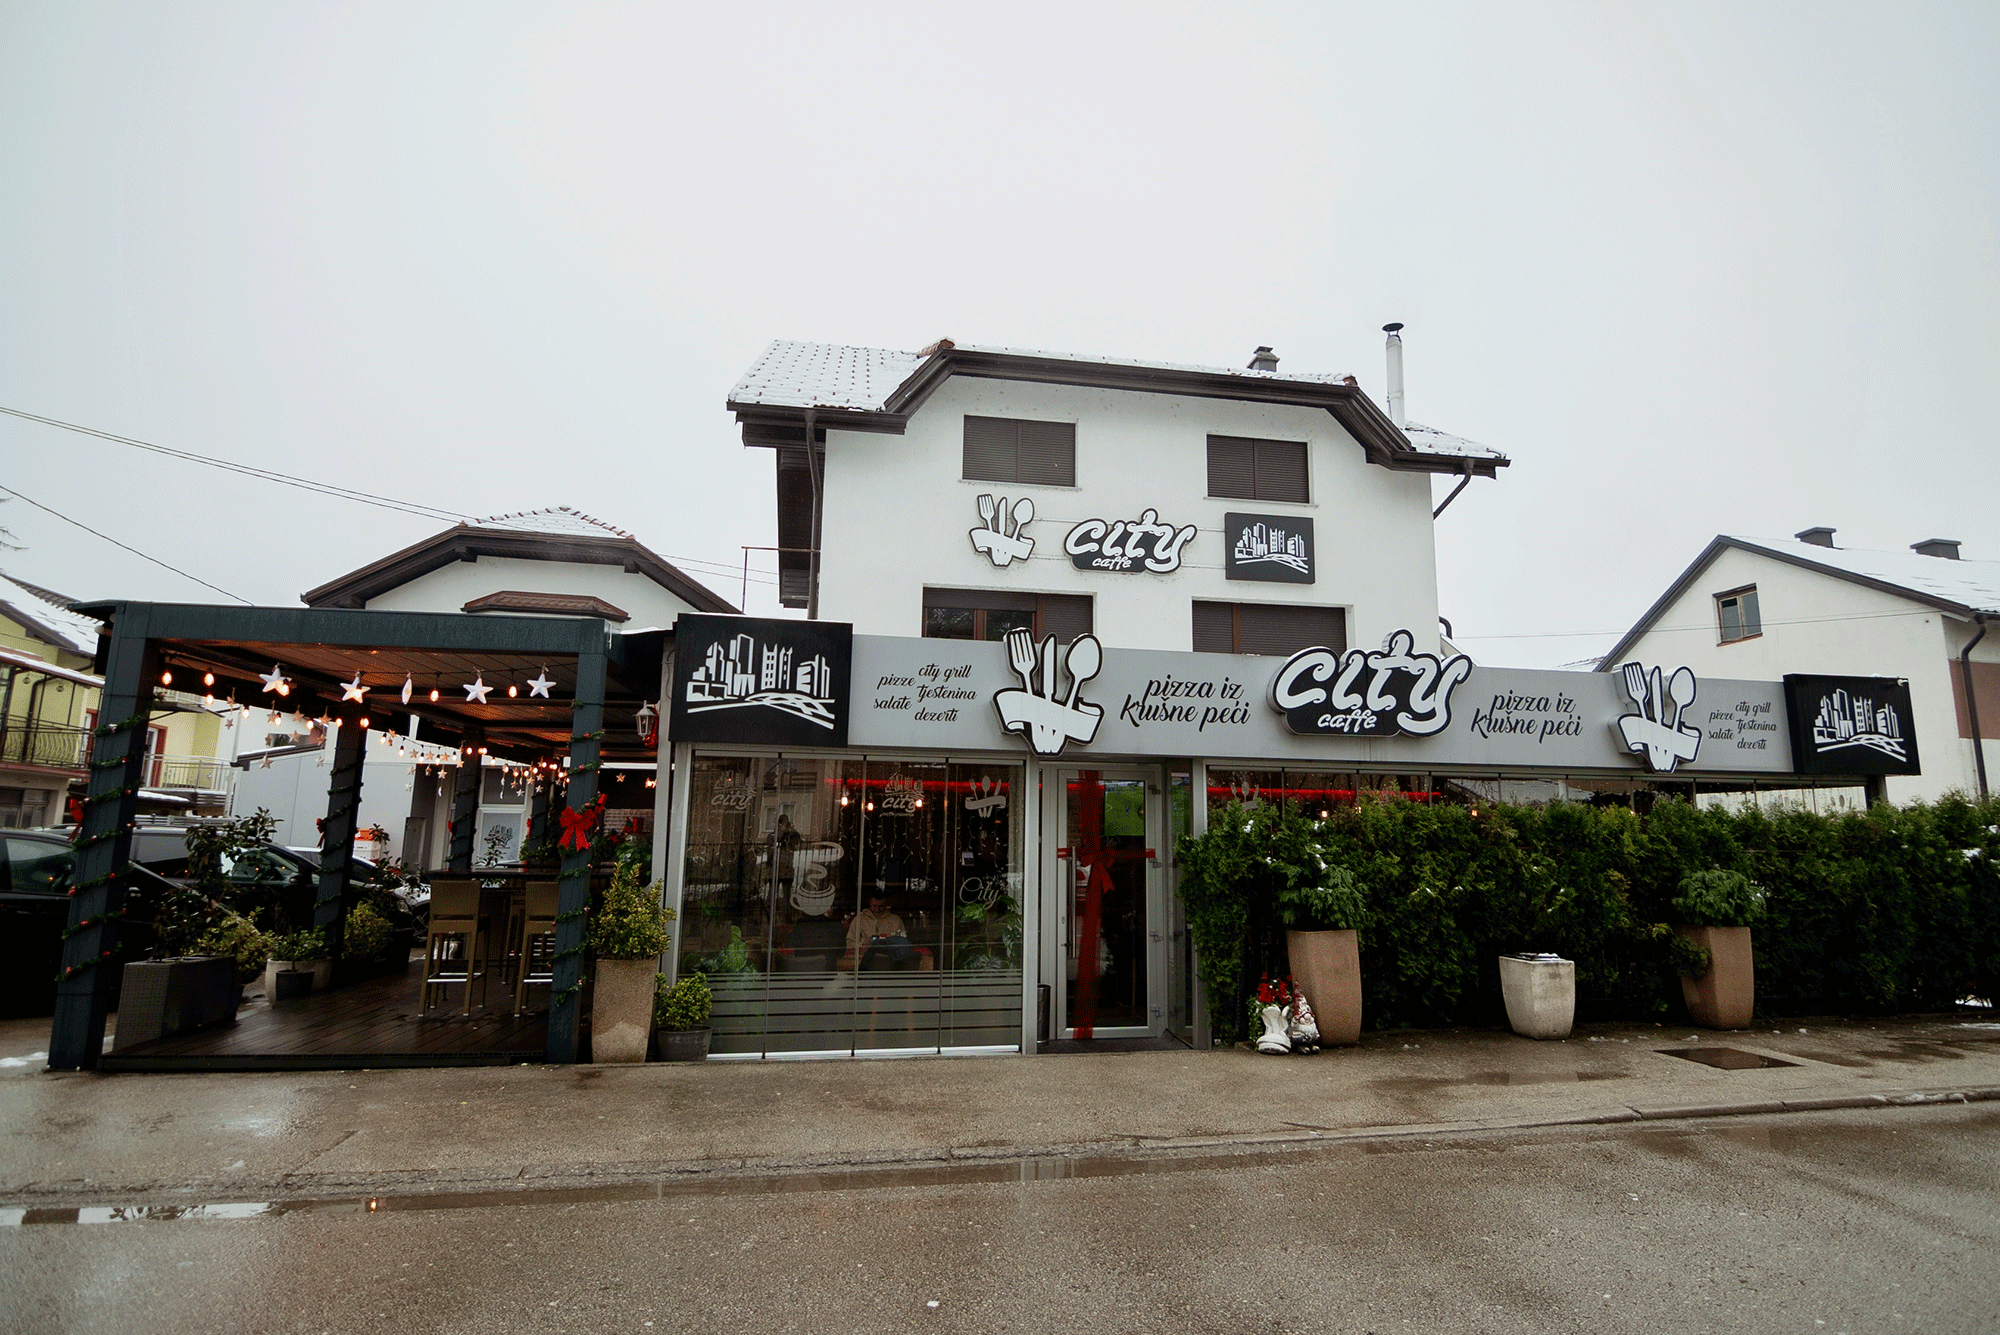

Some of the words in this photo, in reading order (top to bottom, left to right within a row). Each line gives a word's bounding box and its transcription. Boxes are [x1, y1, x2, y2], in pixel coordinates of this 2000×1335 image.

[918, 663, 941, 682] city
[943, 665, 972, 682] grill
[877, 673, 916, 690] pizze
[1142, 674, 1216, 706] pizza
[1220, 676, 1244, 699] iz
[917, 684, 977, 703] tjestenina
[873, 695, 912, 710] salate
[1489, 689, 1552, 718] pizza
[1556, 692, 1576, 713] iz
[1735, 700, 1750, 716] city
[1752, 702, 1772, 717] grill
[914, 707, 959, 722] dezerti
[1198, 700, 1251, 732] peći
[1708, 709, 1734, 723] pizze
[1538, 714, 1583, 743] peći
[1708, 728, 1734, 740] salate
[1735, 718, 1777, 734] tjestenina
[1737, 737, 1767, 750] dezerti
